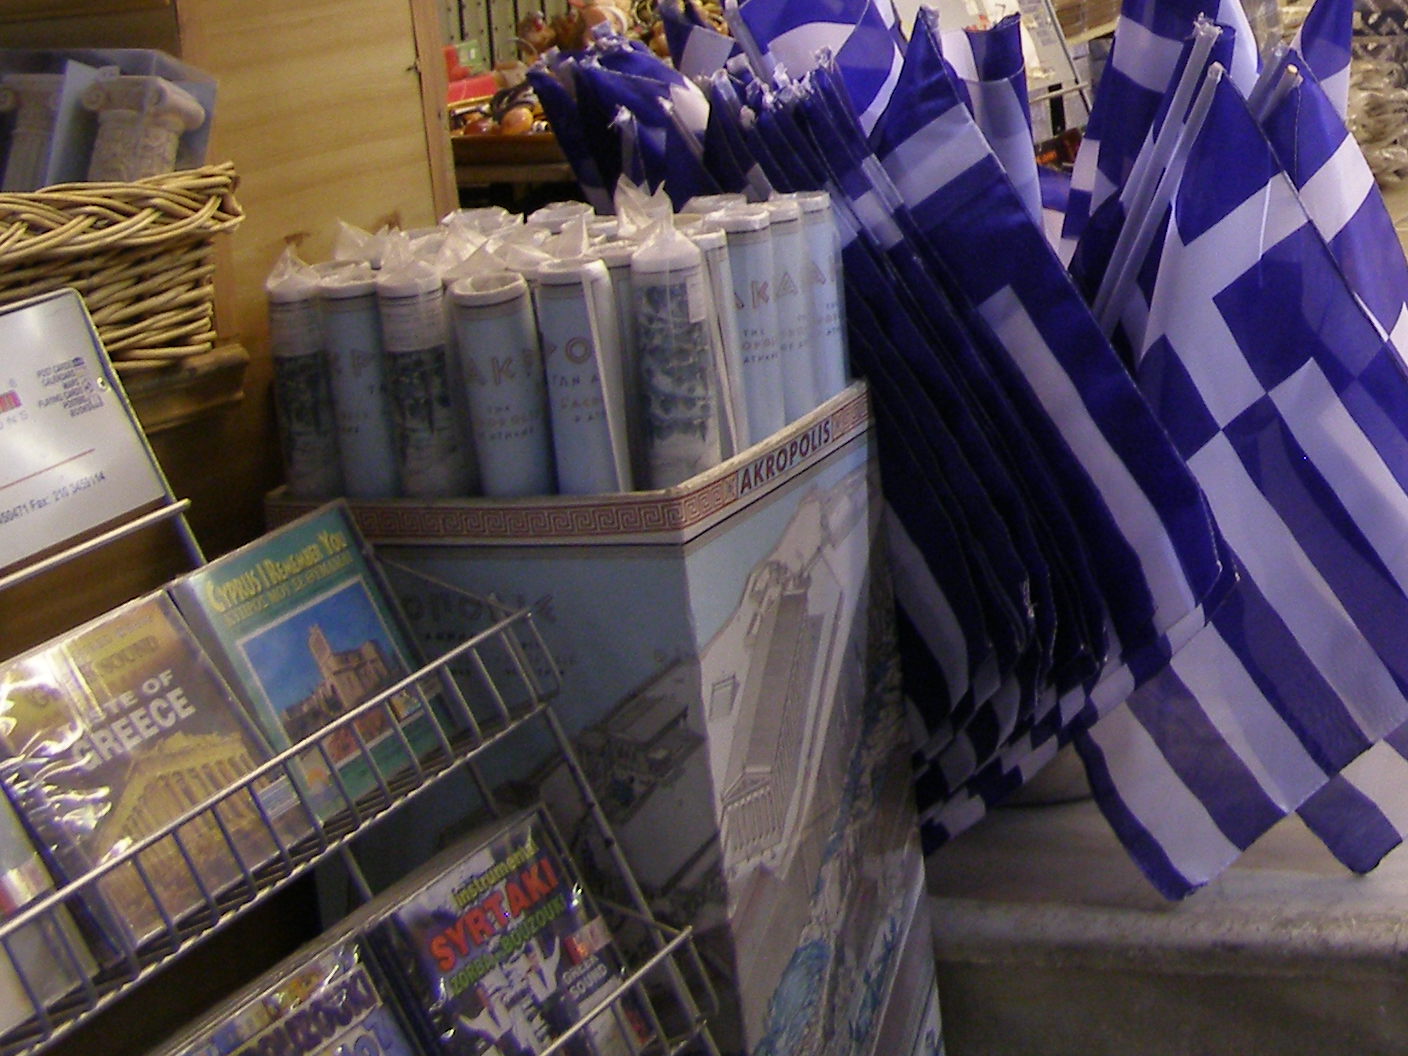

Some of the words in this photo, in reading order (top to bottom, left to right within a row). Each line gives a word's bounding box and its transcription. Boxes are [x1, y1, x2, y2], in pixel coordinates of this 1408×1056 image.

[741, 420, 830, 494] AKROPOLIS
[142, 669, 174, 695] OF
[71, 687, 197, 771] GREECE
[430, 855, 559, 973] SYRTAKI
[568, 962, 608, 1000] SOUND
